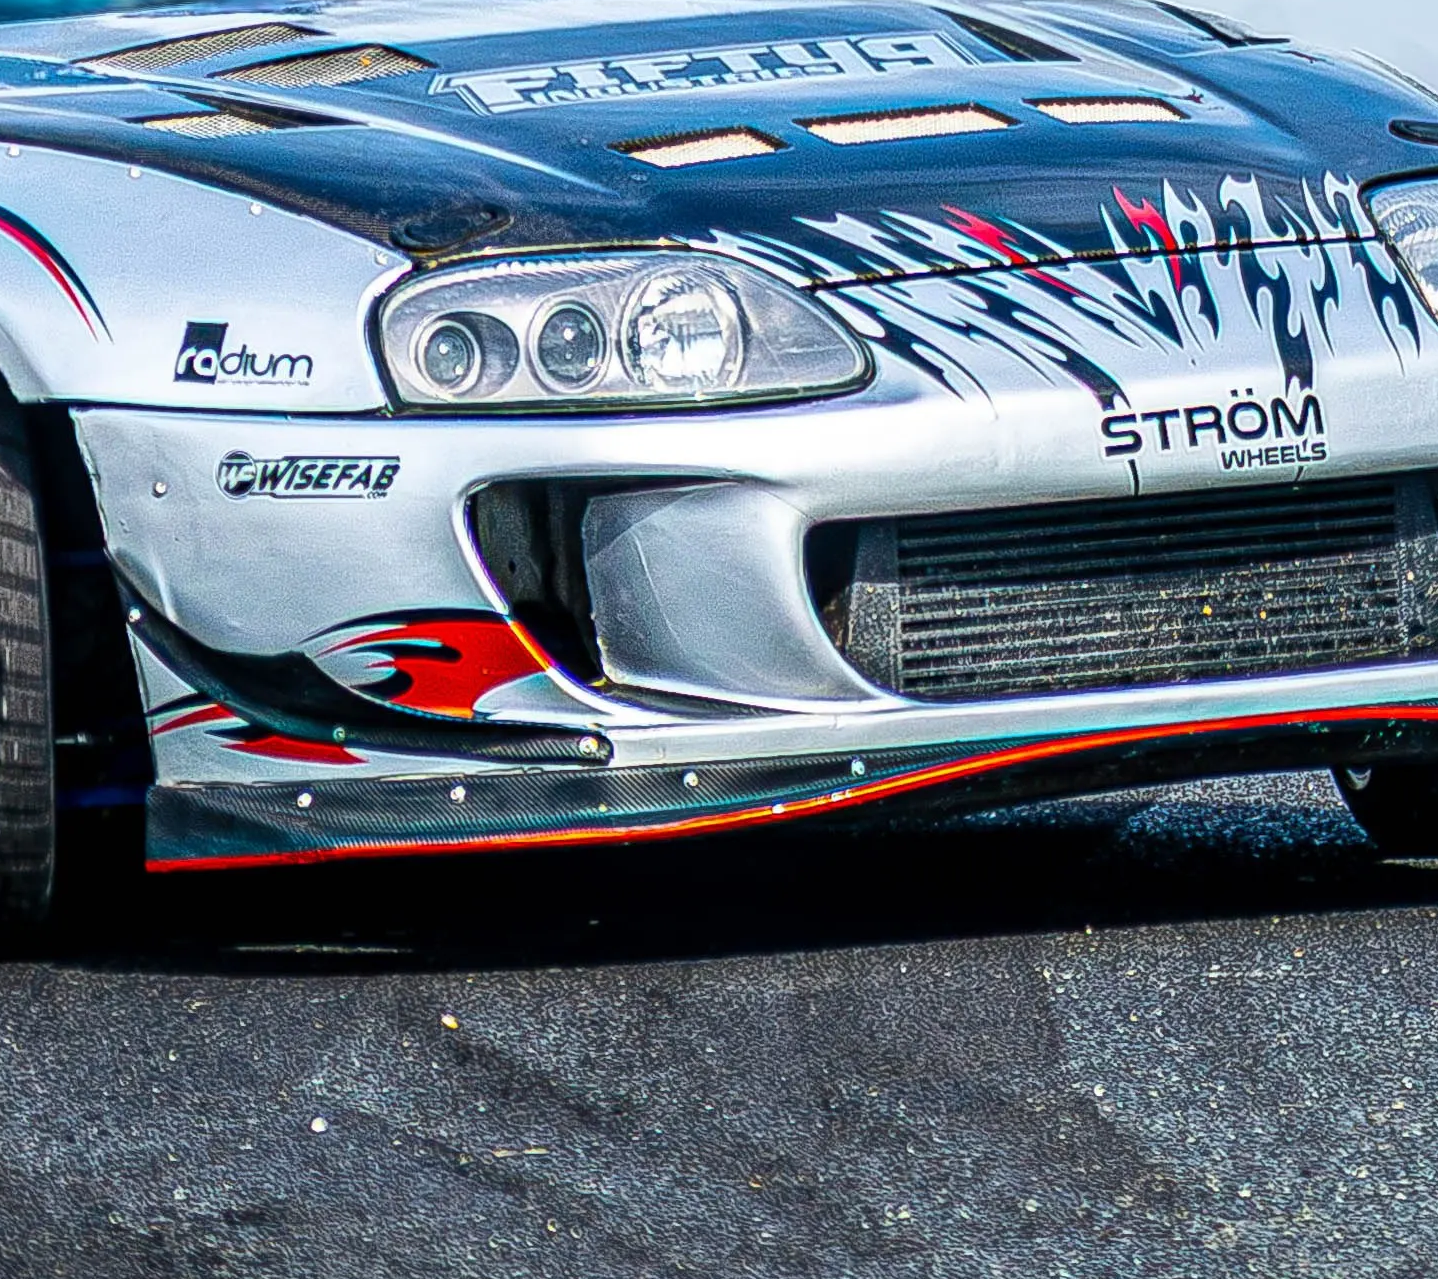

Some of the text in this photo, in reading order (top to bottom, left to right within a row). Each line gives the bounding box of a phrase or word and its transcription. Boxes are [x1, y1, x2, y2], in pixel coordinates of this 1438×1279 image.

[176, 343, 314, 378] radium
[1100, 387, 1325, 458] STRÖM
[1221, 440, 1328, 471] WHEELS
[258, 462, 401, 491] WISEFAB
